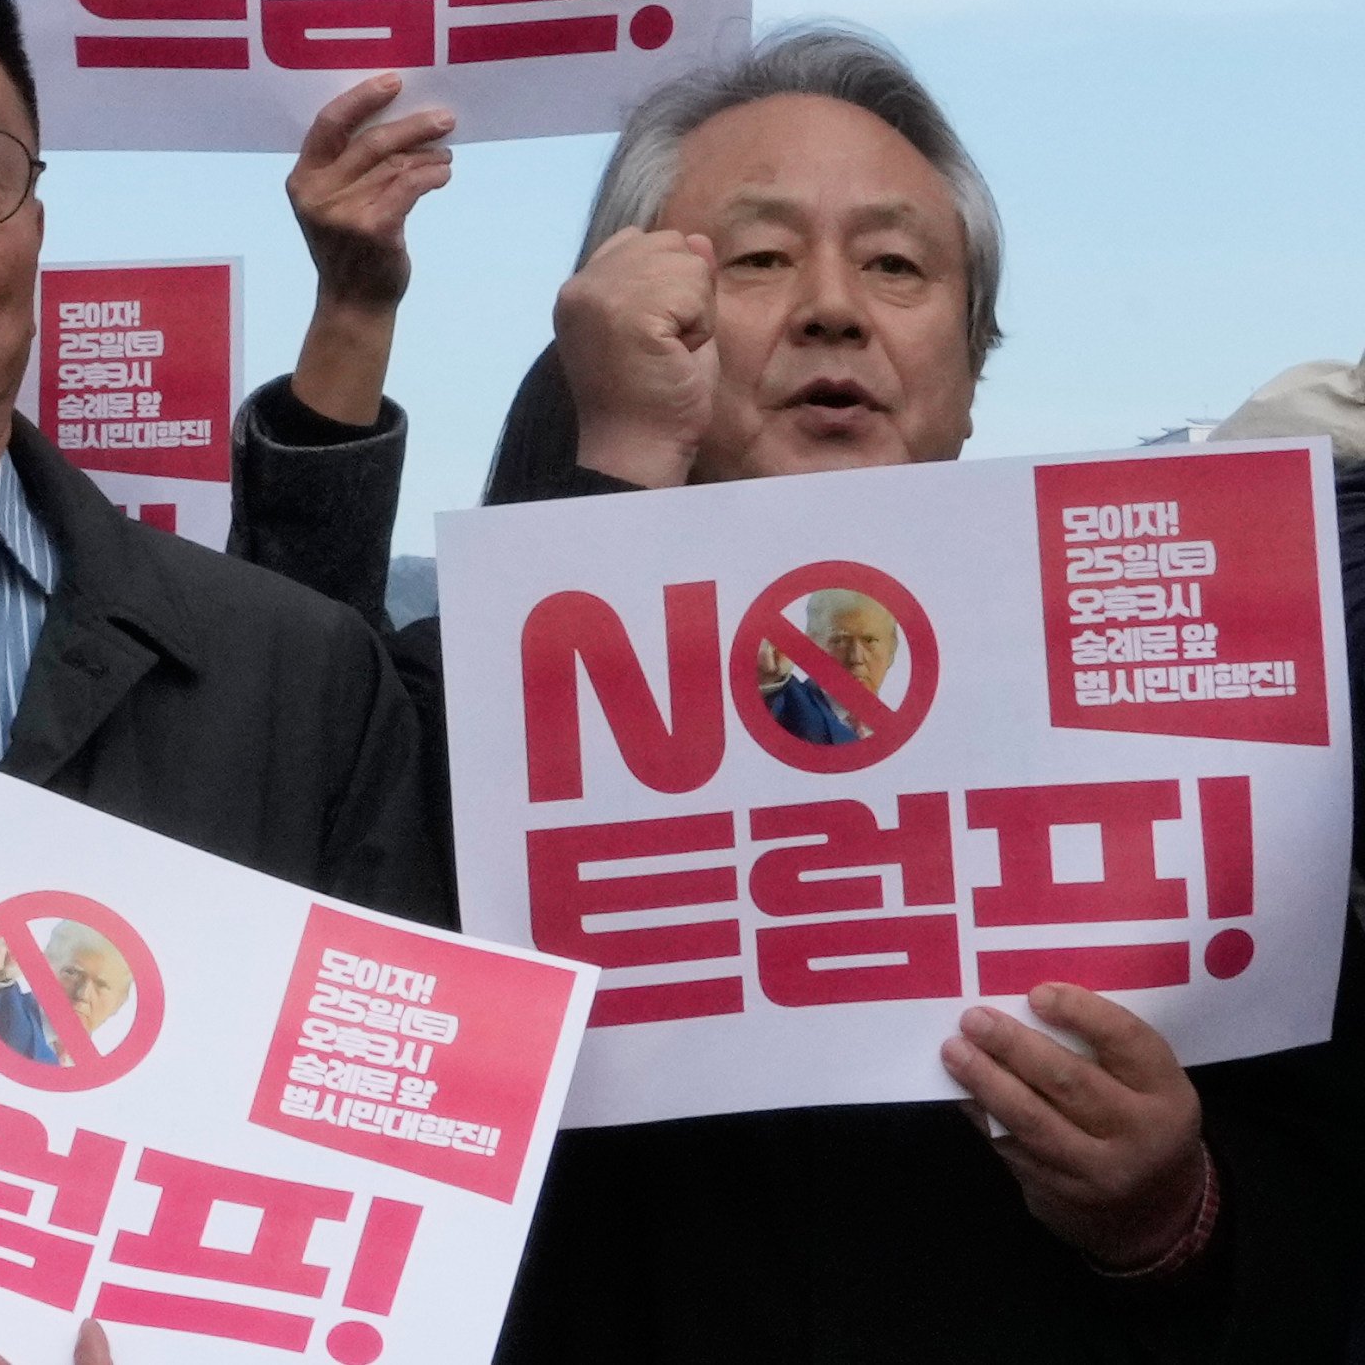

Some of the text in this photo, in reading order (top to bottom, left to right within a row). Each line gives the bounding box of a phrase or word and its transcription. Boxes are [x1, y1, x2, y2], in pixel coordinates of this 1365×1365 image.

[59, 301, 141, 329] 모이자!
[59, 330, 164, 360] 25일(토)
[58, 392, 162, 420] 숭례문 앞
[57, 419, 213, 450] 범시민대행진!
[1063, 501, 1179, 542] 모이자!
[1066, 540, 1217, 583] 25일(토)
[1073, 624, 1218, 665] 숭례문 앞
[521, 560, 940, 803] NO
[1075, 662, 1296, 706] 범시민대행진!
[526, 776, 1255, 1028] 트럼프!
[319, 949, 437, 1004] 모이자!
[309, 983, 459, 1044] 25일(토)
[289, 1054, 437, 1108] 숭례문 앞
[281, 1084, 500, 1155] 범시민대행진!
